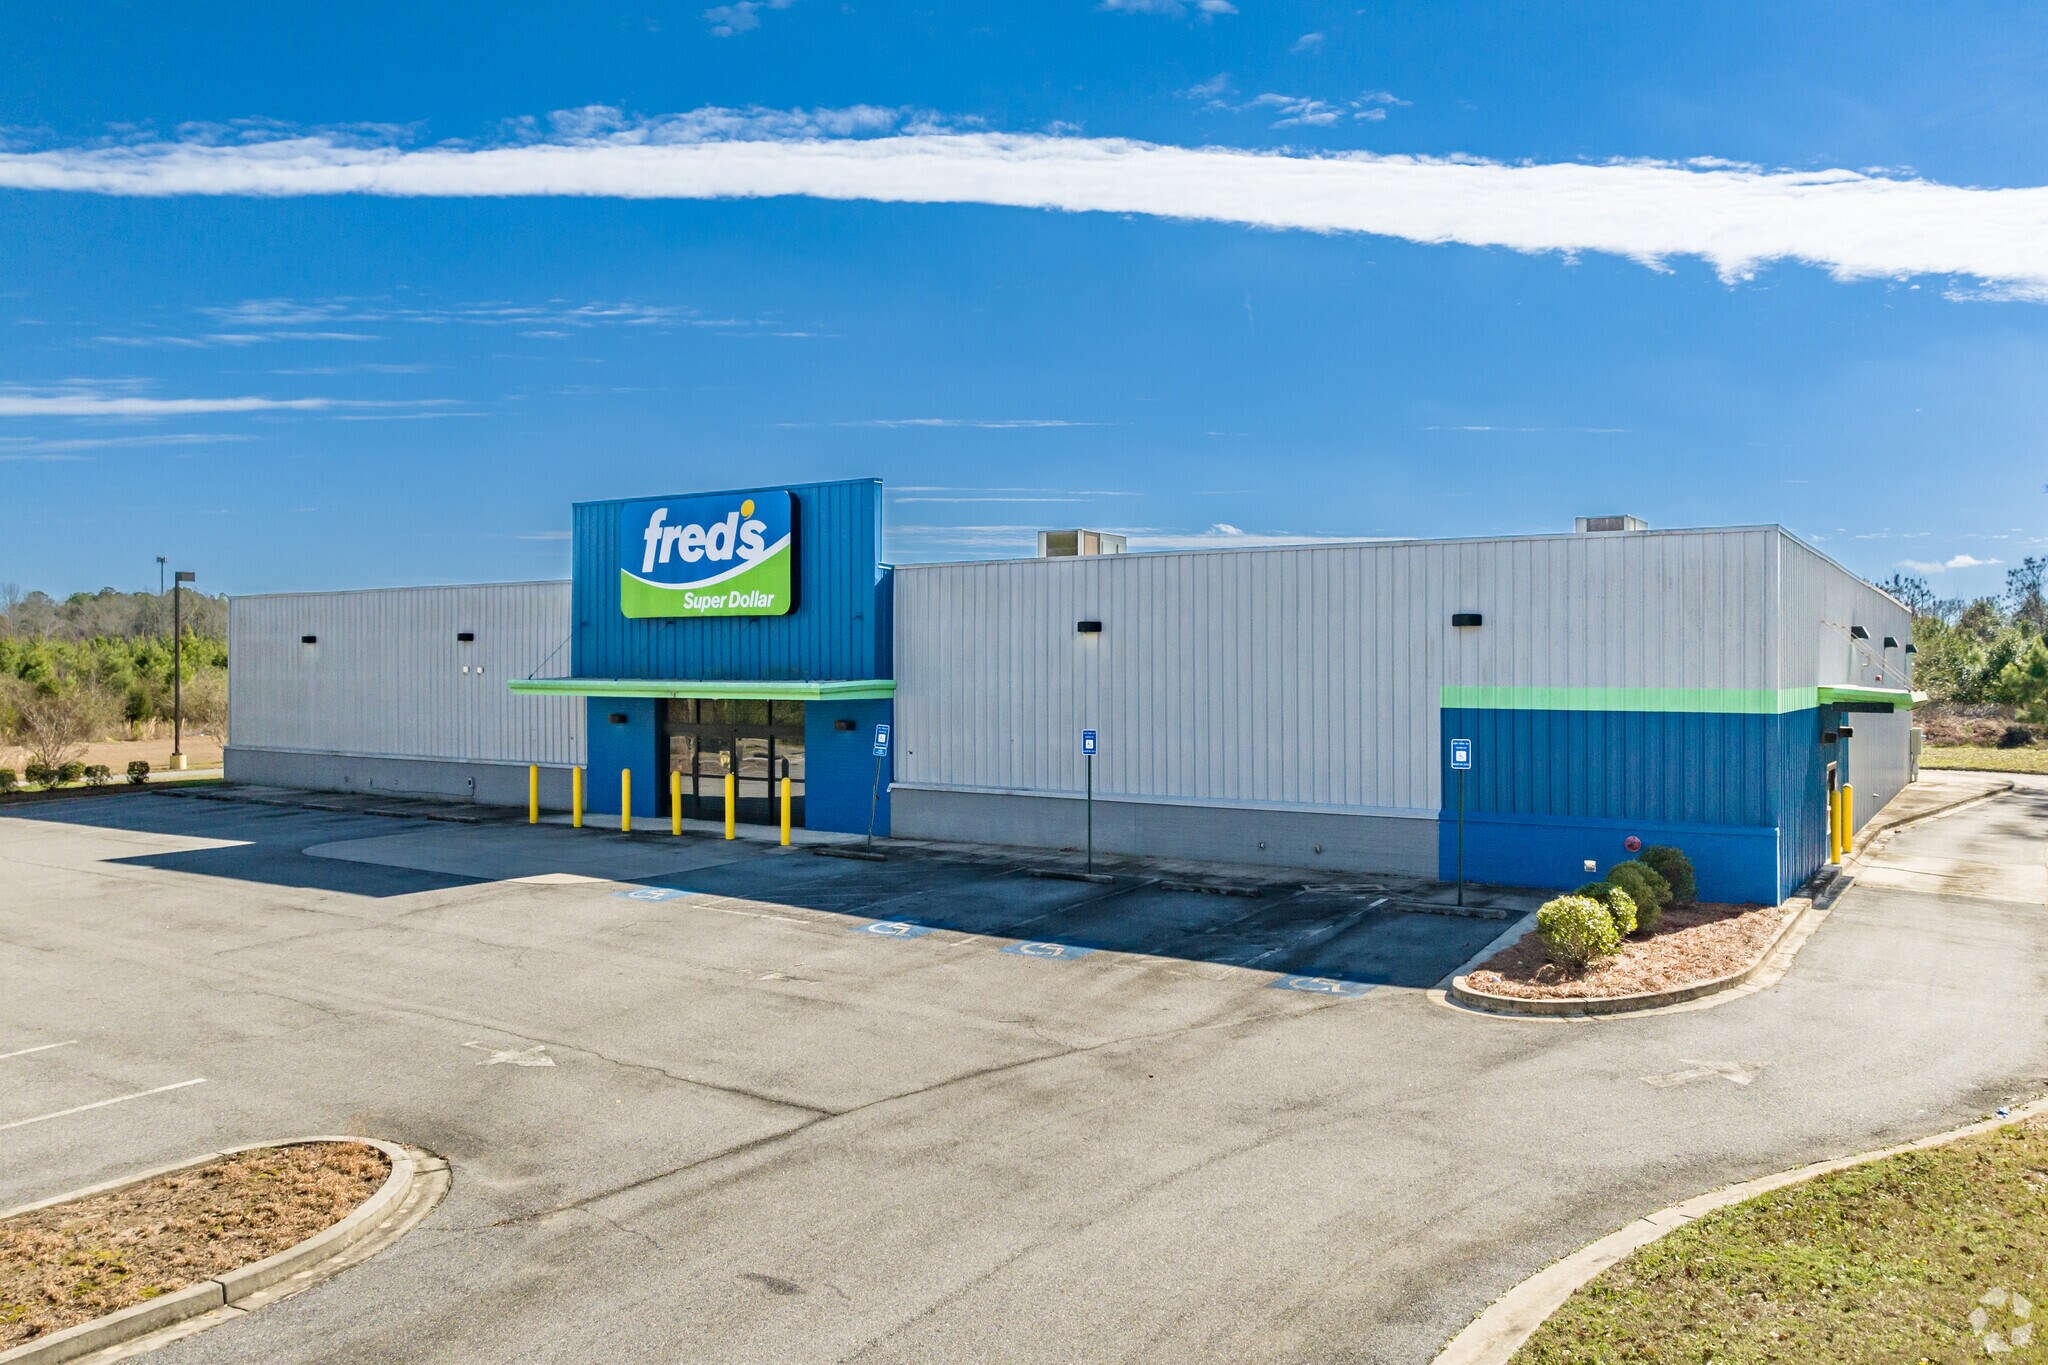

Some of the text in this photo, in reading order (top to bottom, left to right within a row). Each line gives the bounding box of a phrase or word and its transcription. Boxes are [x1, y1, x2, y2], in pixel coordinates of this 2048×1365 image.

[641, 499, 767, 573] fred's
[683, 590, 775, 613] Super Dollar
